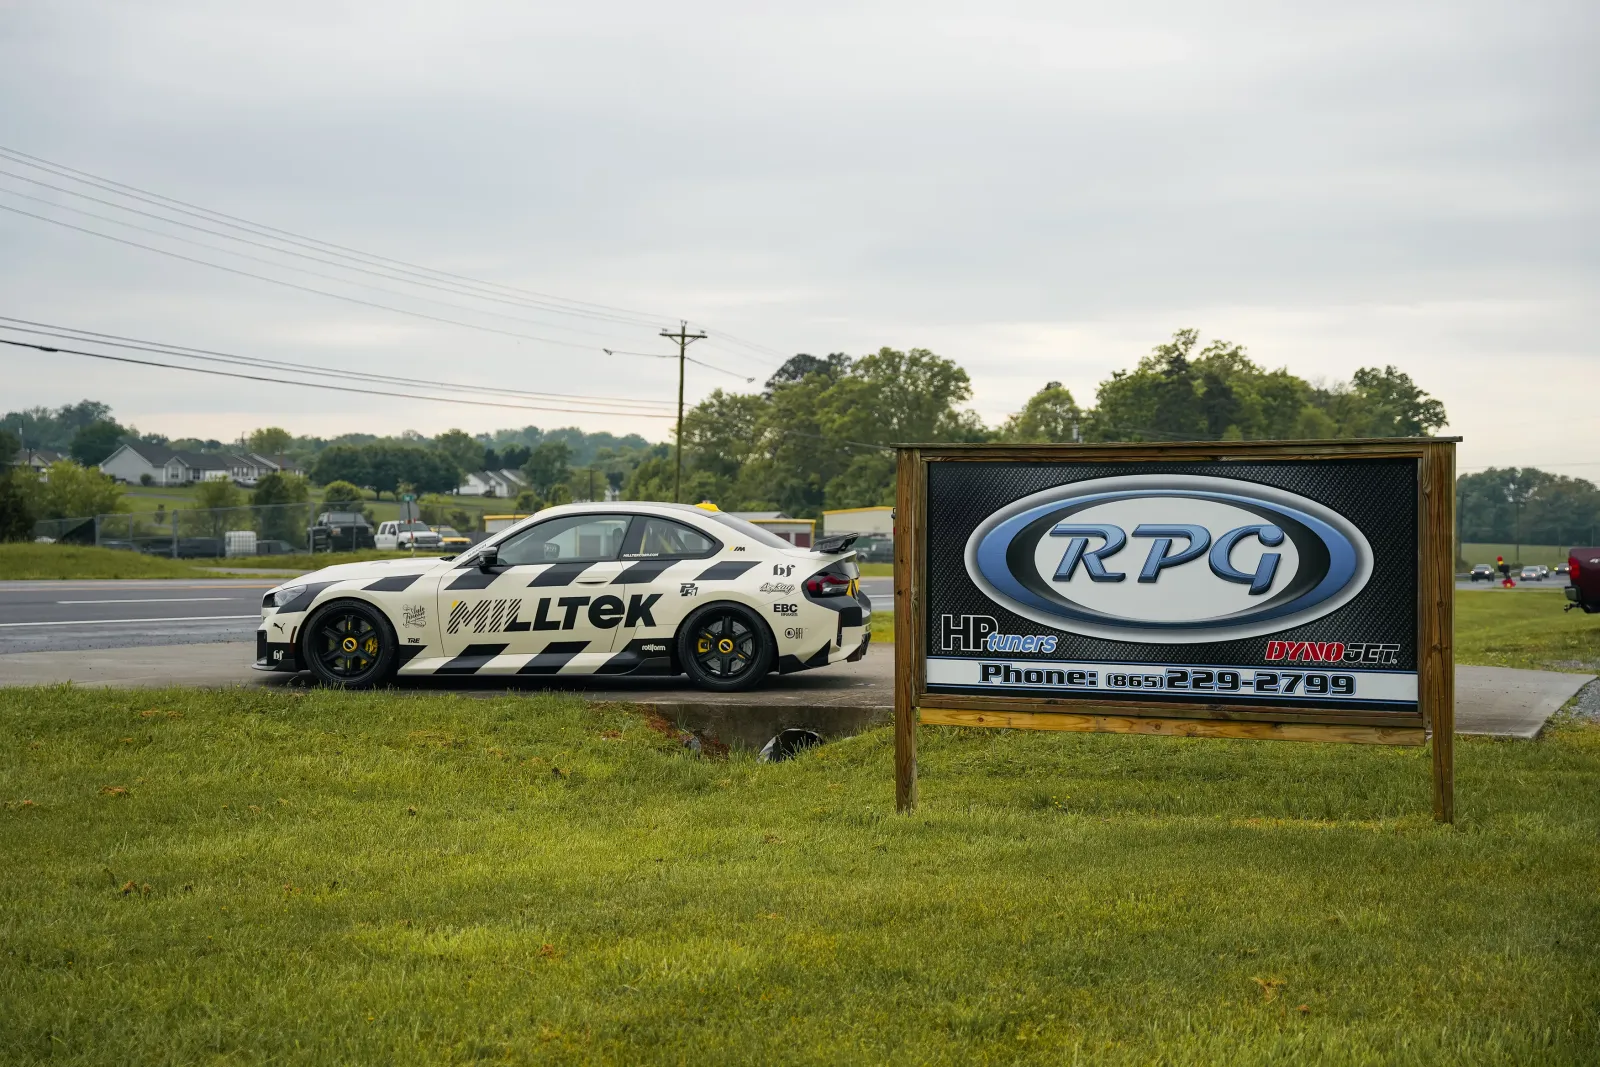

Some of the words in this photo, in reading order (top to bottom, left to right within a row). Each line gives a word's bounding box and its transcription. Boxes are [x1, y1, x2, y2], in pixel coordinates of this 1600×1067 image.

[1049, 523, 1285, 595] RPG
[773, 603, 798, 613] EBC
[641, 643, 666, 652] rotiform
[986, 631, 1058, 653] tuners
[978, 662, 1098, 688] Phone:
